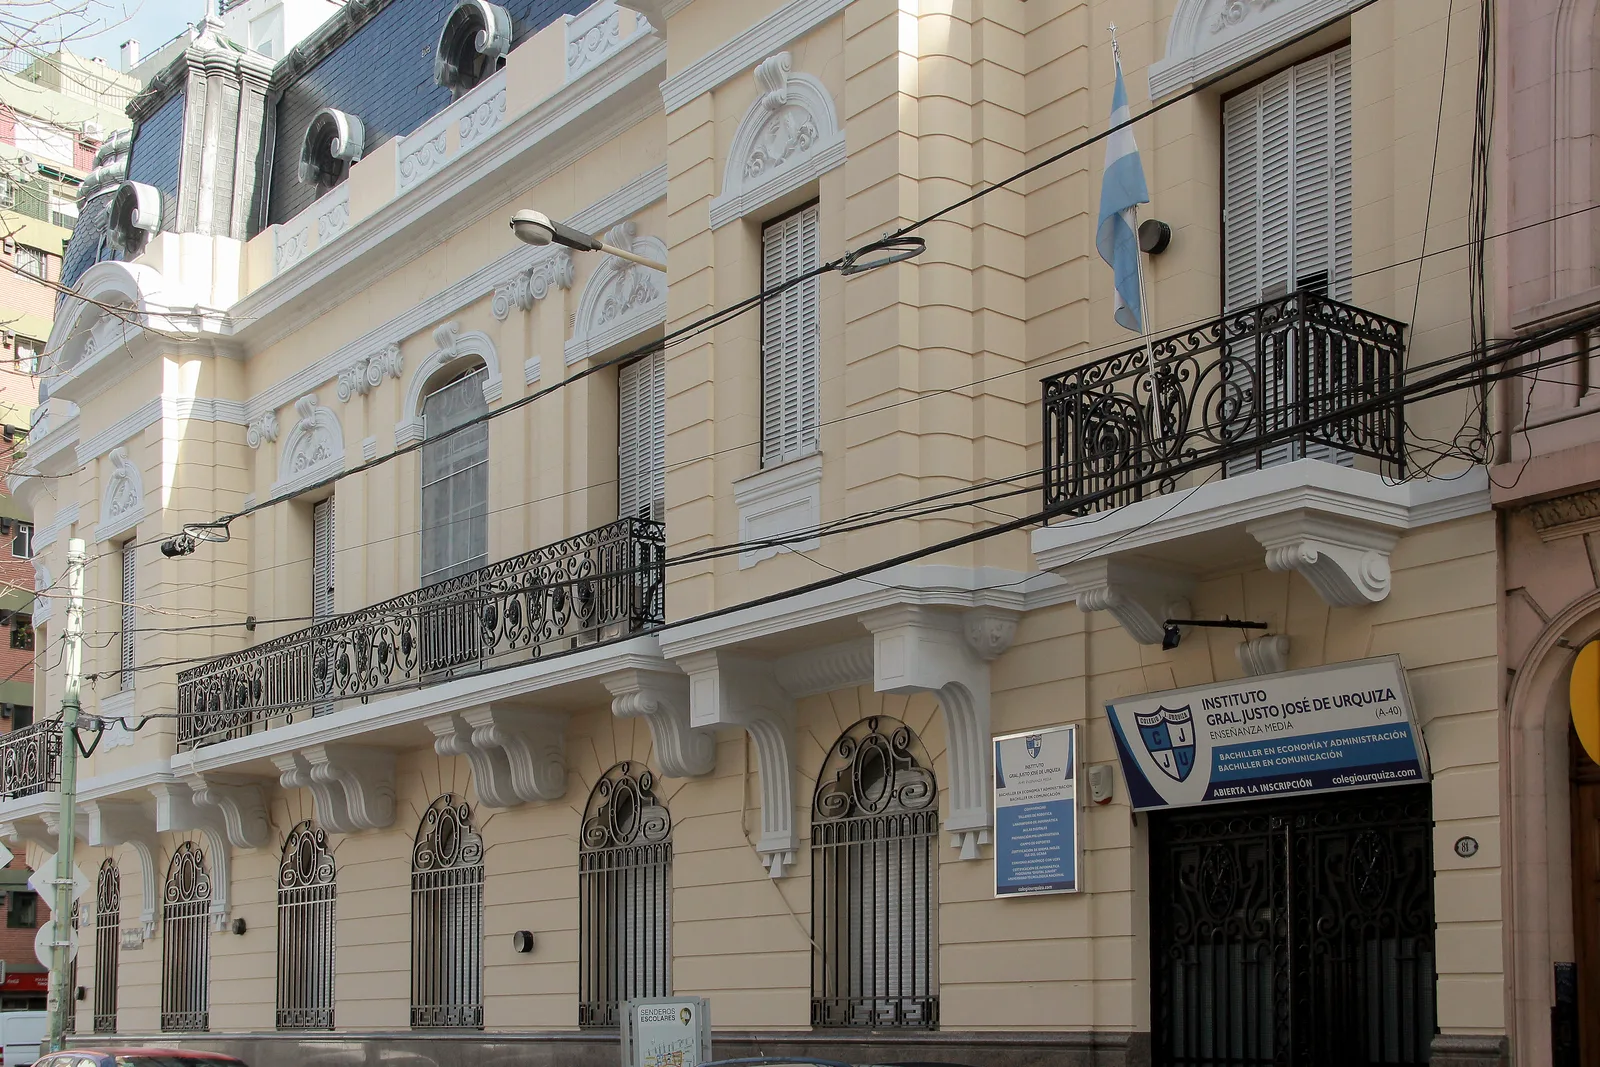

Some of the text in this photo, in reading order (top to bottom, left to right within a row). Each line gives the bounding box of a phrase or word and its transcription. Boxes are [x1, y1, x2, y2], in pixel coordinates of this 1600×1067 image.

[1201, 690, 1267, 710] INSTITUTO
[1206, 688, 1396, 726] GRAL. JUSTO JOSÉ DE URQUIZA
[1375, 705, 1402, 720] (A-40)
[1152, 727, 1186, 745] C J
[1210, 721, 1294, 740] ENSEÑANZA MEDIA
[1219, 730, 1407, 761] BACHILLER EN ECONOMÍA Y ADMINISTRACIÓN
[1163, 751, 1188, 768] J U
[1218, 750, 1343, 772] BACHILLER EN COMUNICACIÓN
[1332, 768, 1416, 785] colegiourquiza.com
[1213, 777, 1313, 797] ABIERTA LA INSCRIPCIÓN
